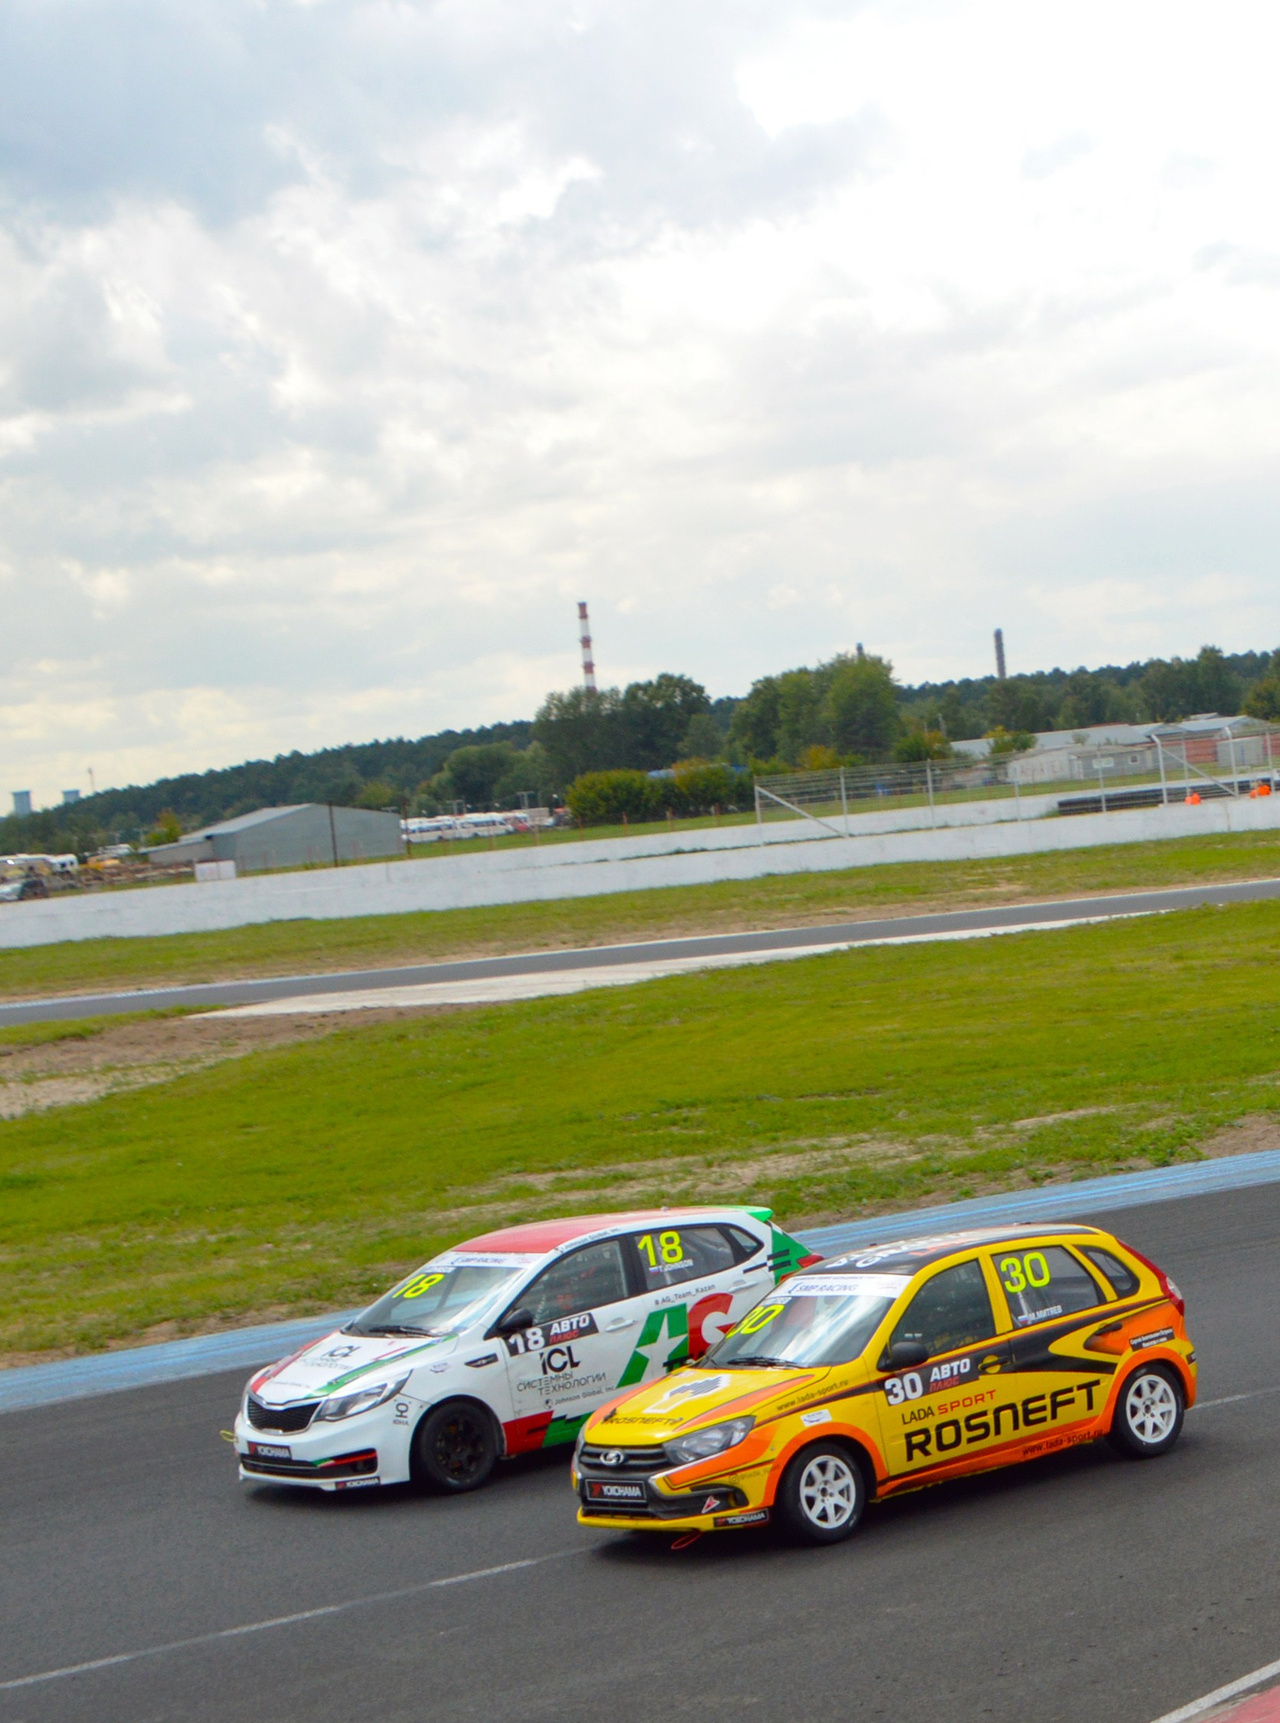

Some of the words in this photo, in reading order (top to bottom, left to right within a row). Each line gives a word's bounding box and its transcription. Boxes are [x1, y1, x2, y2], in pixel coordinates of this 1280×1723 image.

[637, 1230, 684, 1267] 18
[1000, 1251, 1051, 1293] 30
[392, 1273, 445, 1299] 18
[818, 1282, 859, 1293] RACING
[550, 1314, 590, 1336] АВТО
[725, 1304, 785, 1339] 30
[508, 1327, 546, 1355] 18
[549, 1329, 579, 1345] ПЛЮС
[930, 1358, 971, 1383] АВТО
[538, 1372, 607, 1396] ТЕХНОЛОГИИ
[777, 1380, 849, 1411] www.lada-sport.ru
[884, 1372, 924, 1406] 30
[928, 1376, 960, 1393] ПЛЮС
[901, 1406, 935, 1426] LADA
[937, 1390, 997, 1416] SPORT
[904, 1379, 1101, 1462] ROSNEFT
[1022, 1429, 1104, 1456] www.lada-sport.ru
[602, 1485, 642, 1497] YOKOHAMA
[726, 1511, 766, 1525] YOKOHAMA
